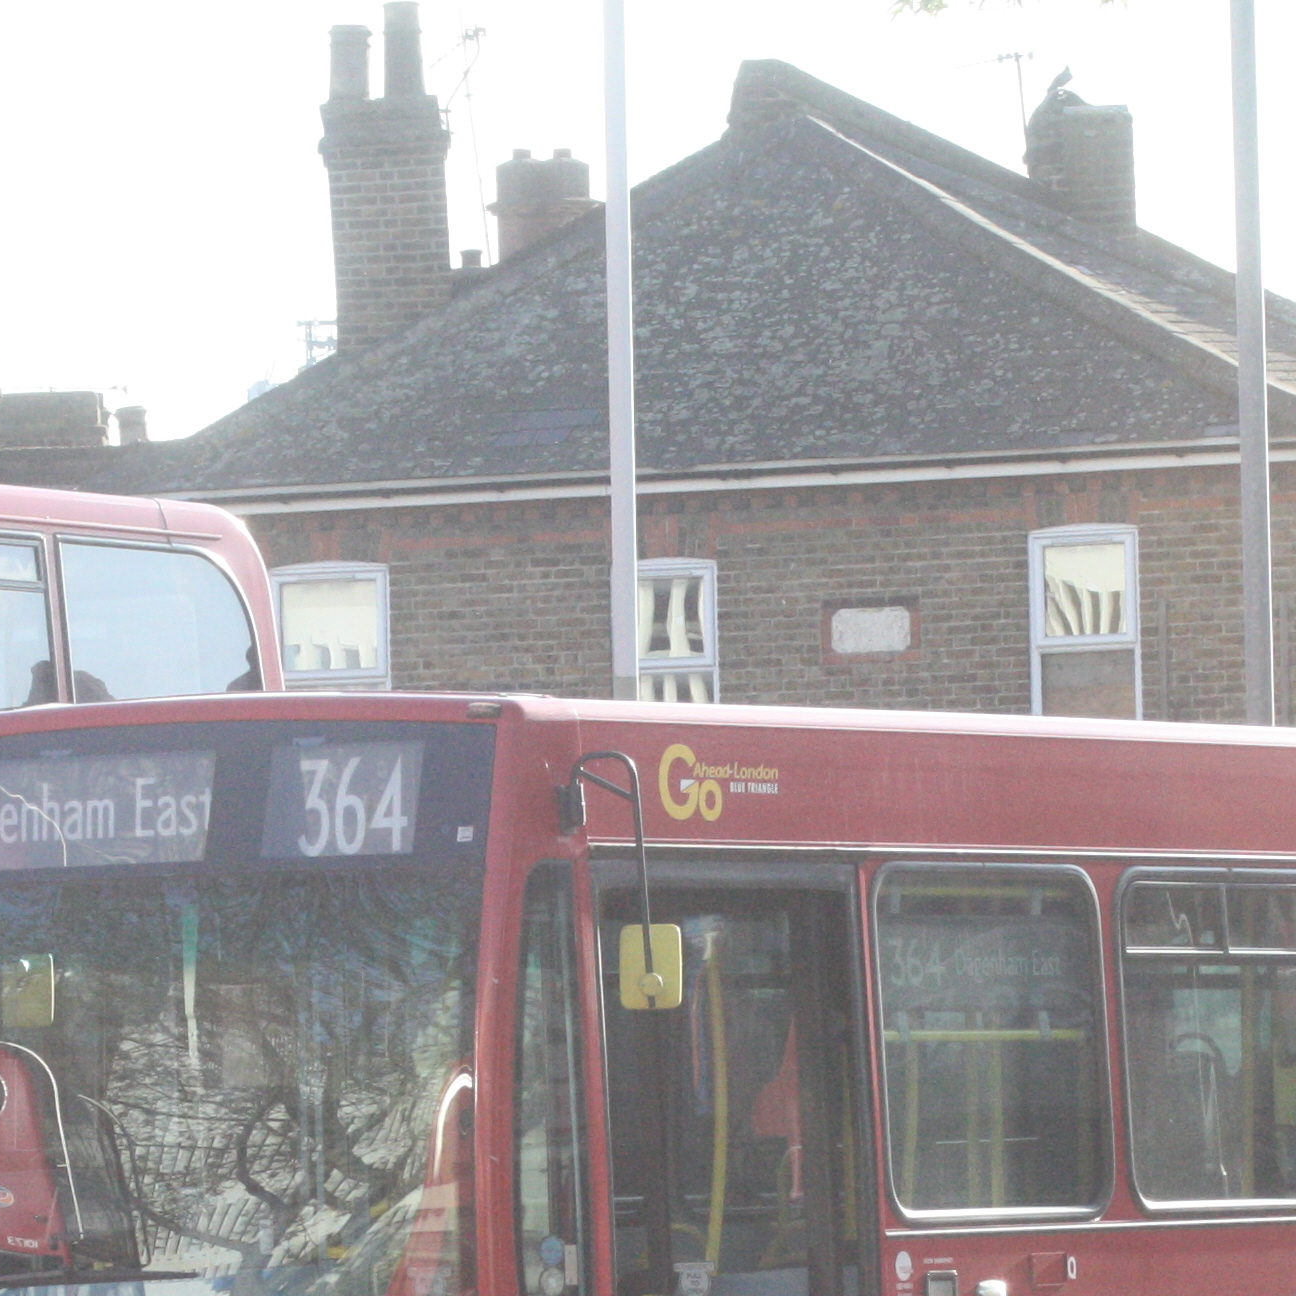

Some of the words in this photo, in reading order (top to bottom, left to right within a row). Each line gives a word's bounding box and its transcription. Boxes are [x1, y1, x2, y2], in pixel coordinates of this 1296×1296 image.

[658, 743, 723, 823] Go
[693, 761, 779, 780] Ahead-London
[729, 781, 746, 793] BLUE
[747, 782, 779, 794] TRIANGLE
[298, 756, 408, 857] 364
